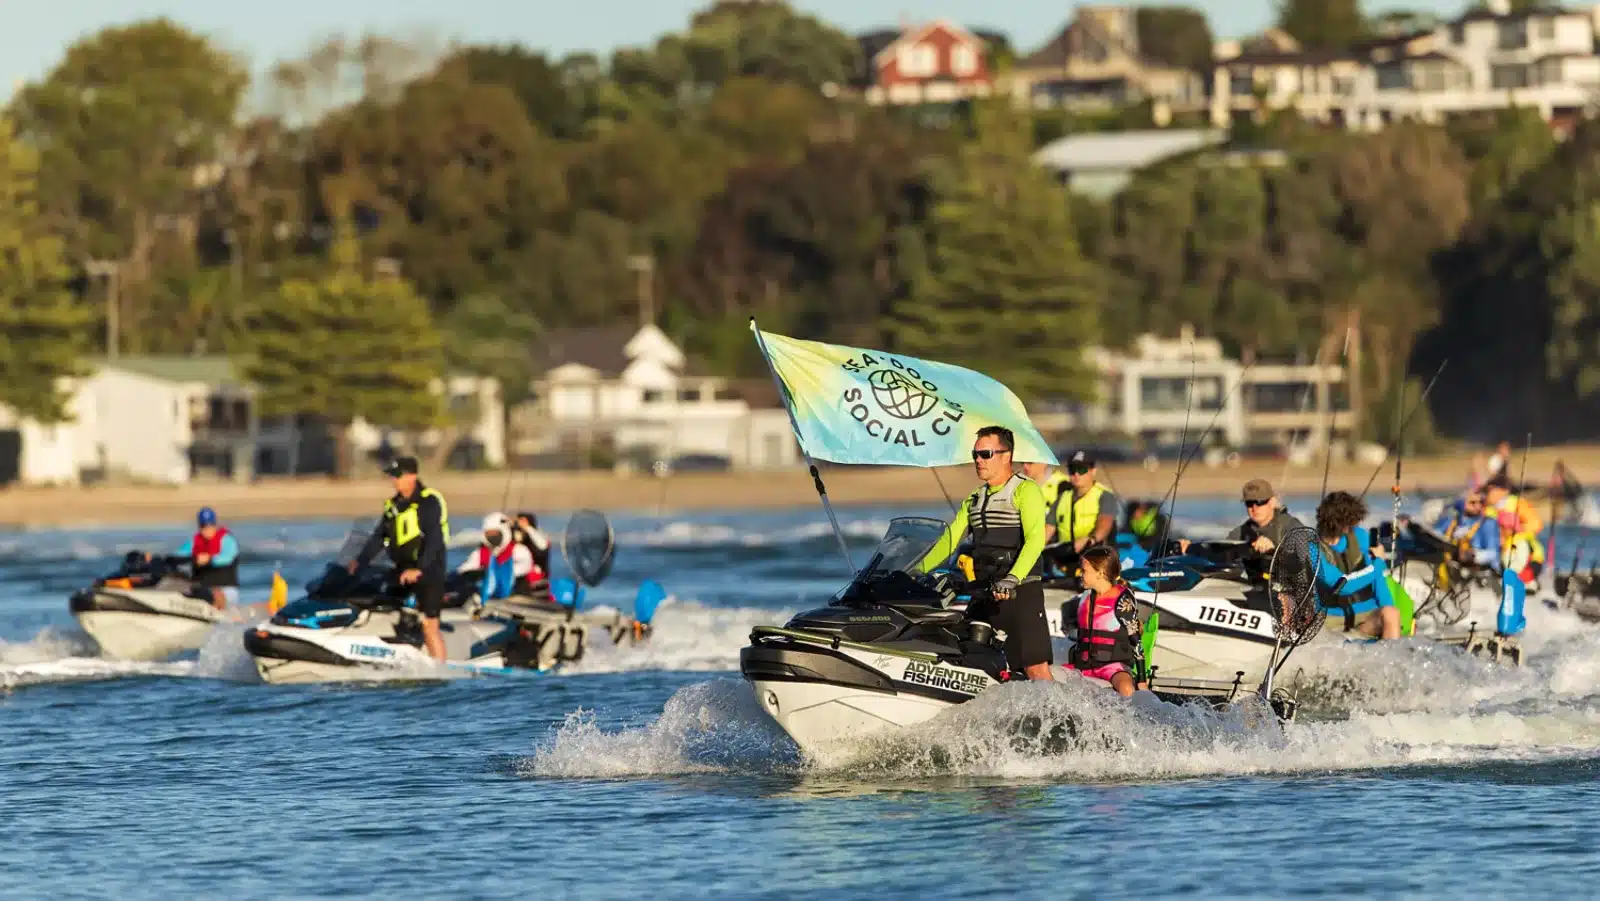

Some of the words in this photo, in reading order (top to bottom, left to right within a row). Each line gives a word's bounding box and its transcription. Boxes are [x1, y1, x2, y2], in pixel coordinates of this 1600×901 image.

[844, 388, 925, 447] SOCIAL
[931, 398, 965, 436] CL
[1199, 606, 1261, 629] 116159
[905, 661, 989, 687] ADVENTURE
